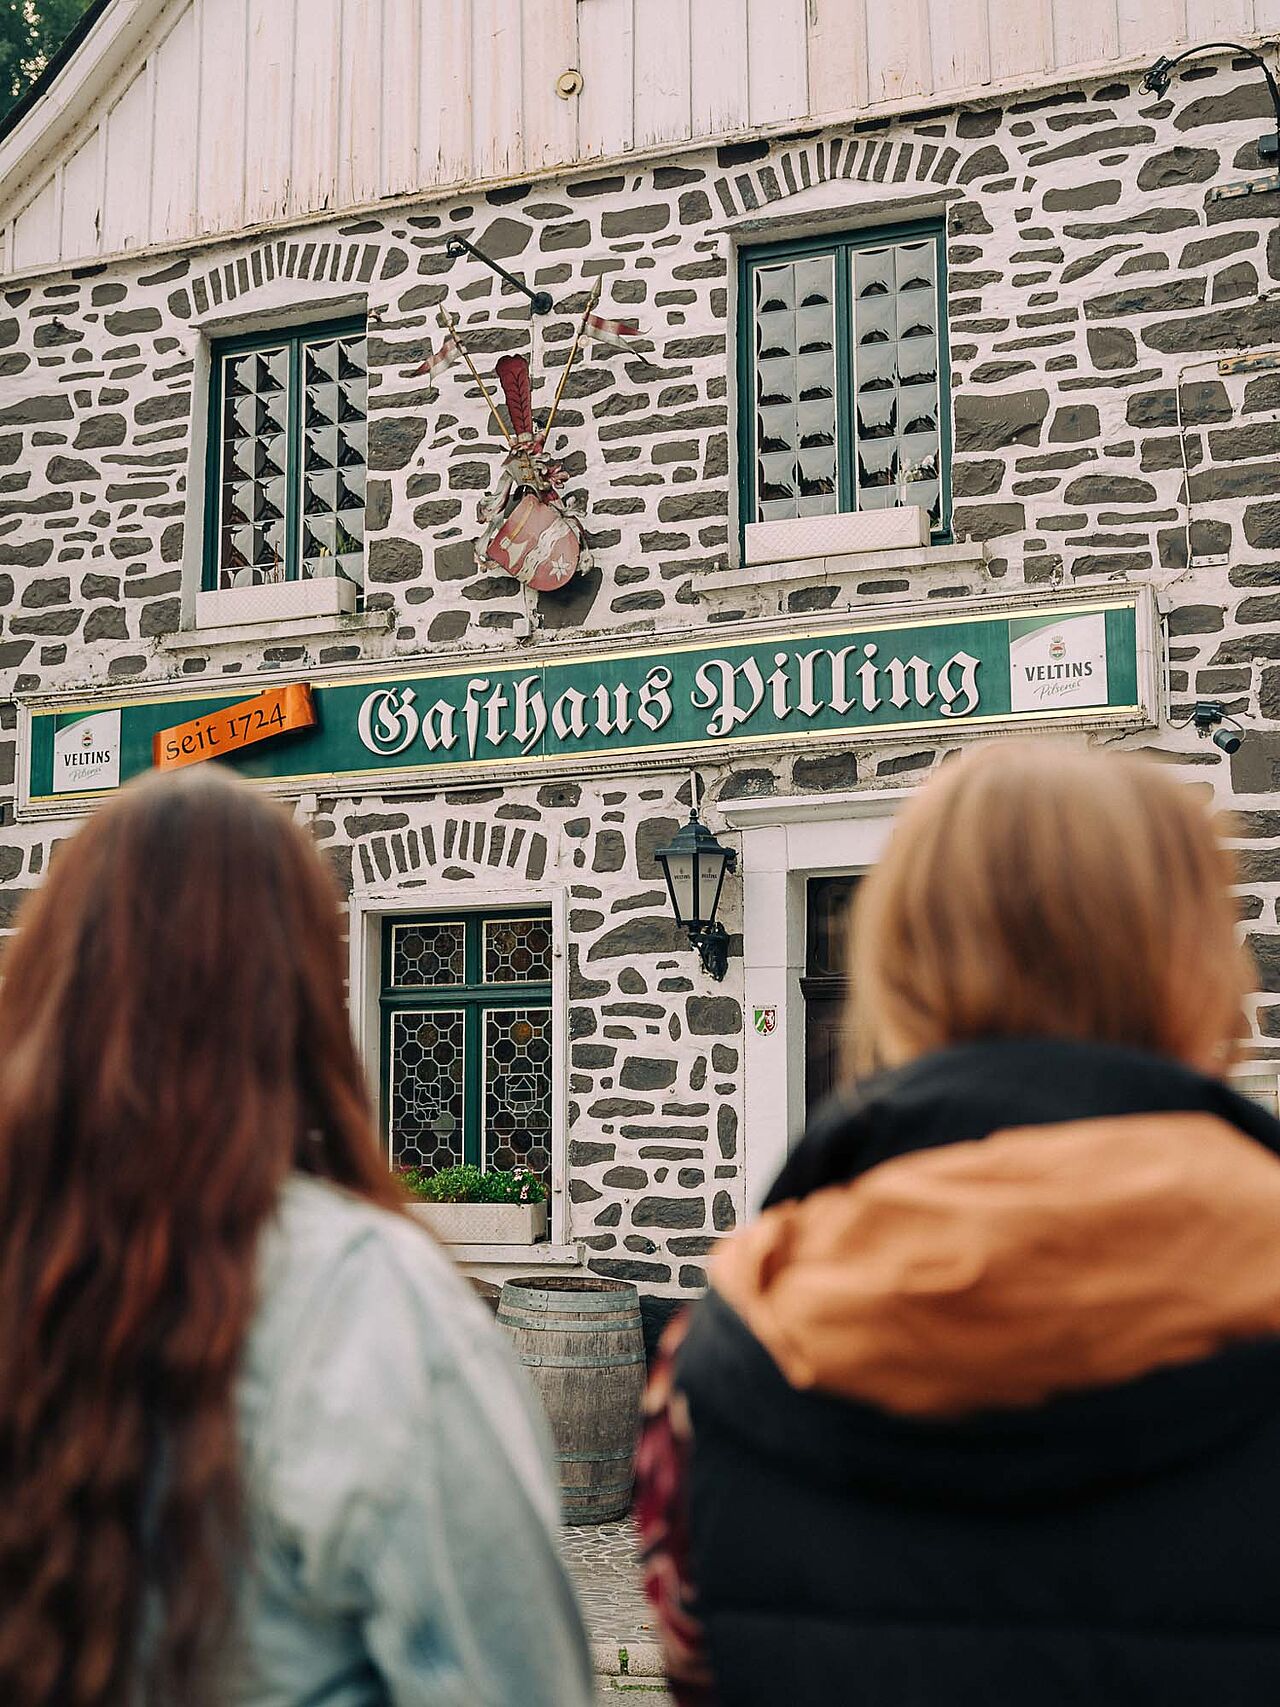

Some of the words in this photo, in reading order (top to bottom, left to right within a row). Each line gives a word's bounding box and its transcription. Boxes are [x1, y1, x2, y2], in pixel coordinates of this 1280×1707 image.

[690, 643, 983, 737] Pilling
[1025, 661, 1093, 682] VELTINS
[166, 721, 220, 761] seit
[227, 702, 287, 741] 1724
[64, 750, 111, 767] VELTINS
